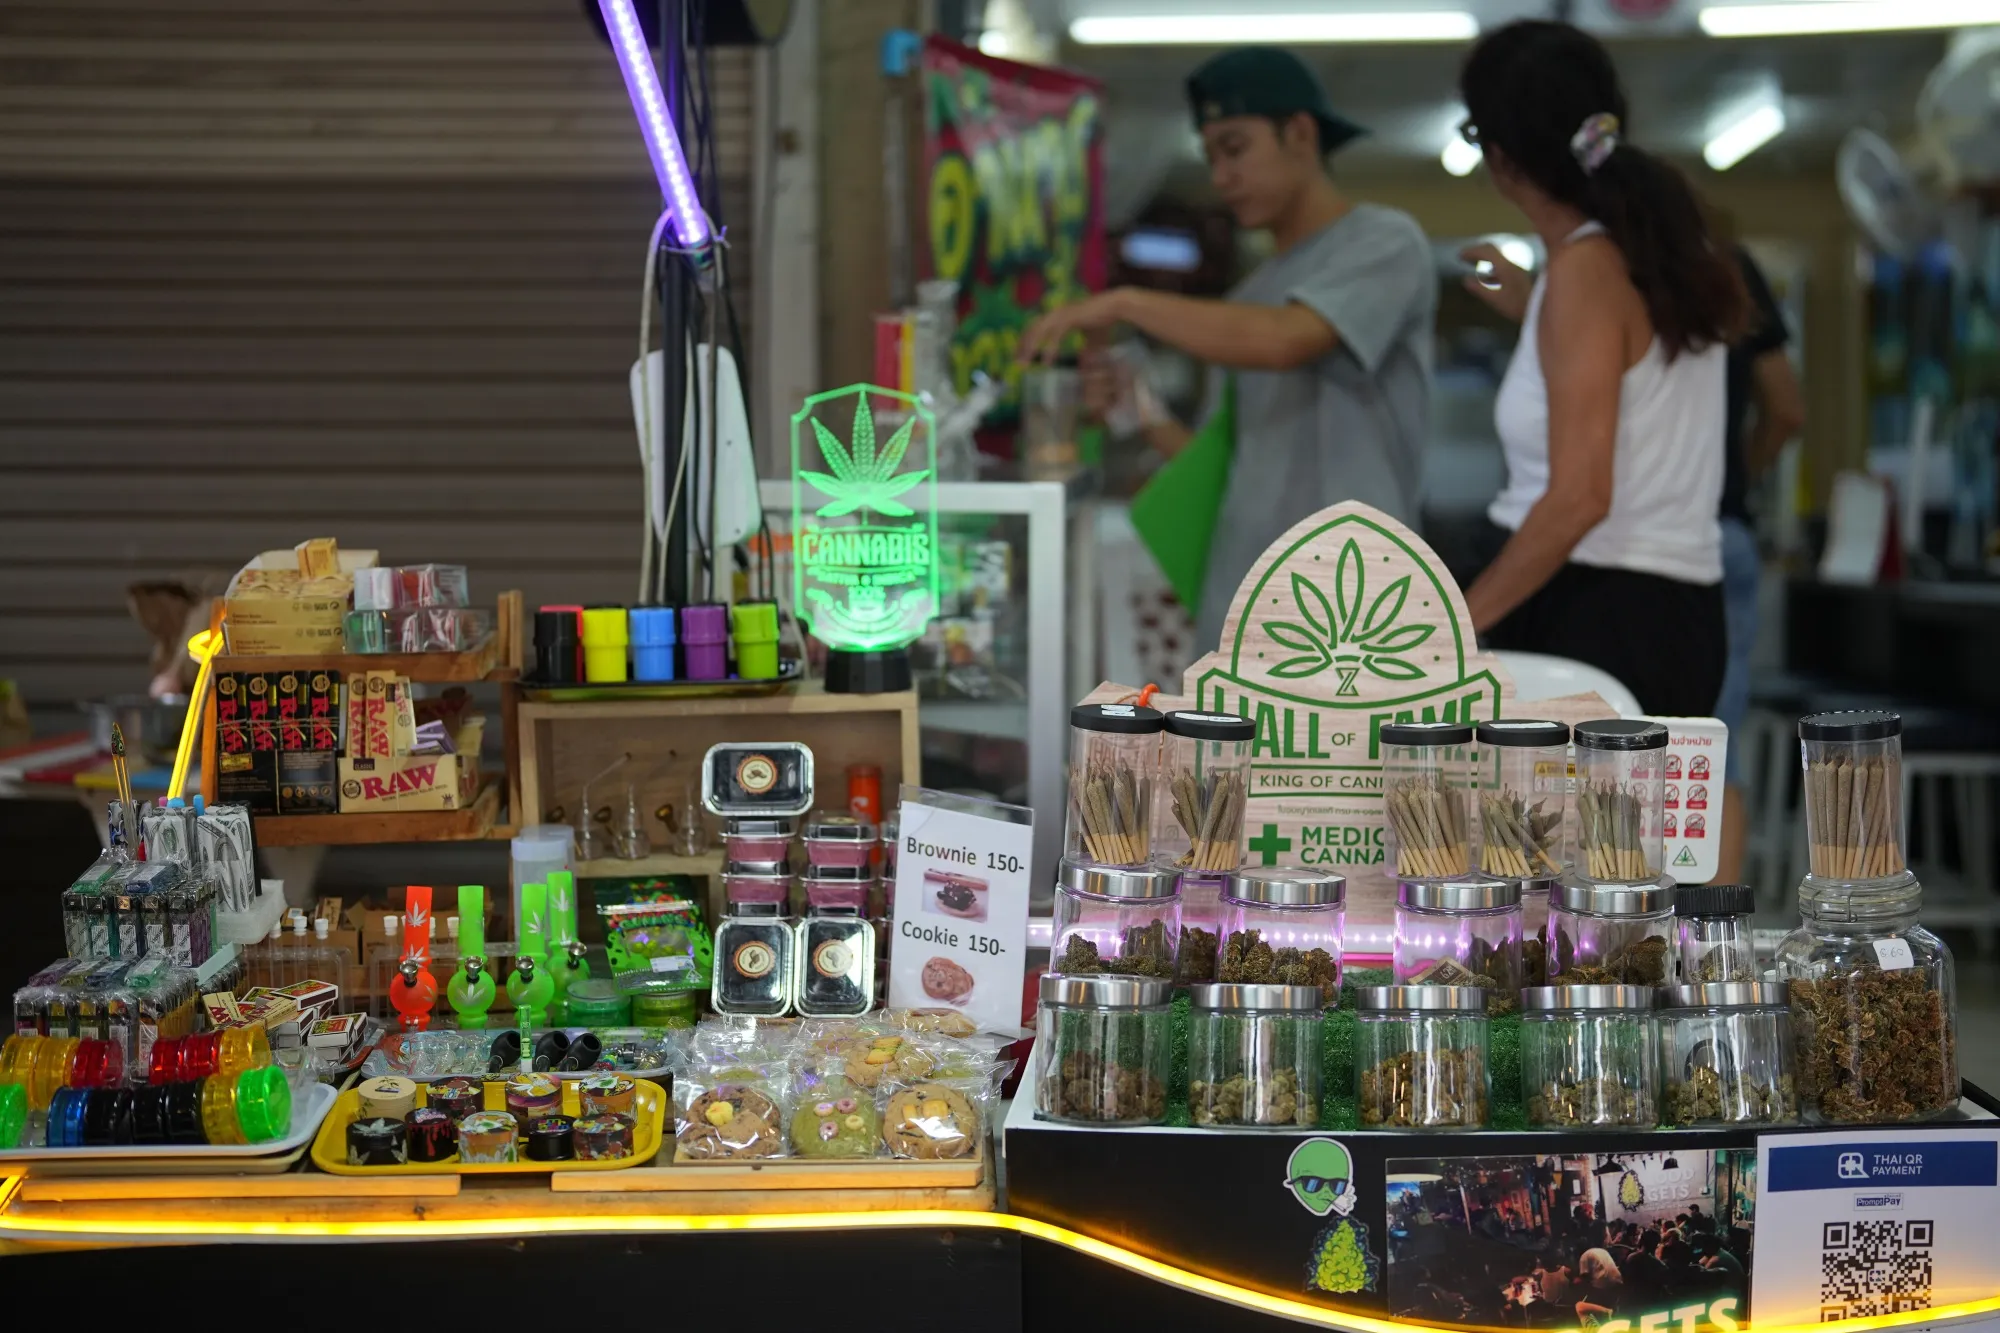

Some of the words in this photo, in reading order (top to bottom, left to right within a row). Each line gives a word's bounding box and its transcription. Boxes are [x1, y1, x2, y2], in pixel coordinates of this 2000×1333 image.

[802, 533, 930, 566] CANNABIS
[366, 697, 389, 758] RAW
[1331, 732, 1356, 747] OF
[361, 763, 438, 800] RAW
[1260, 774, 1303, 788] KING
[1310, 775, 1333, 788] OF
[1302, 825, 1385, 847] MEDIC
[906, 836, 977, 866] Brownie
[986, 852, 1025, 873] 150-
[1300, 847, 1385, 865] CANNA
[901, 920, 959, 947] Cookie
[968, 934, 1006, 956] 150-
[1873, 1154, 1902, 1166] THAI
[1905, 1153, 1923, 1165] QR
[1872, 1165, 1923, 1176] PAYMENT
[1856, 1197, 1901, 1207] PromptPay
